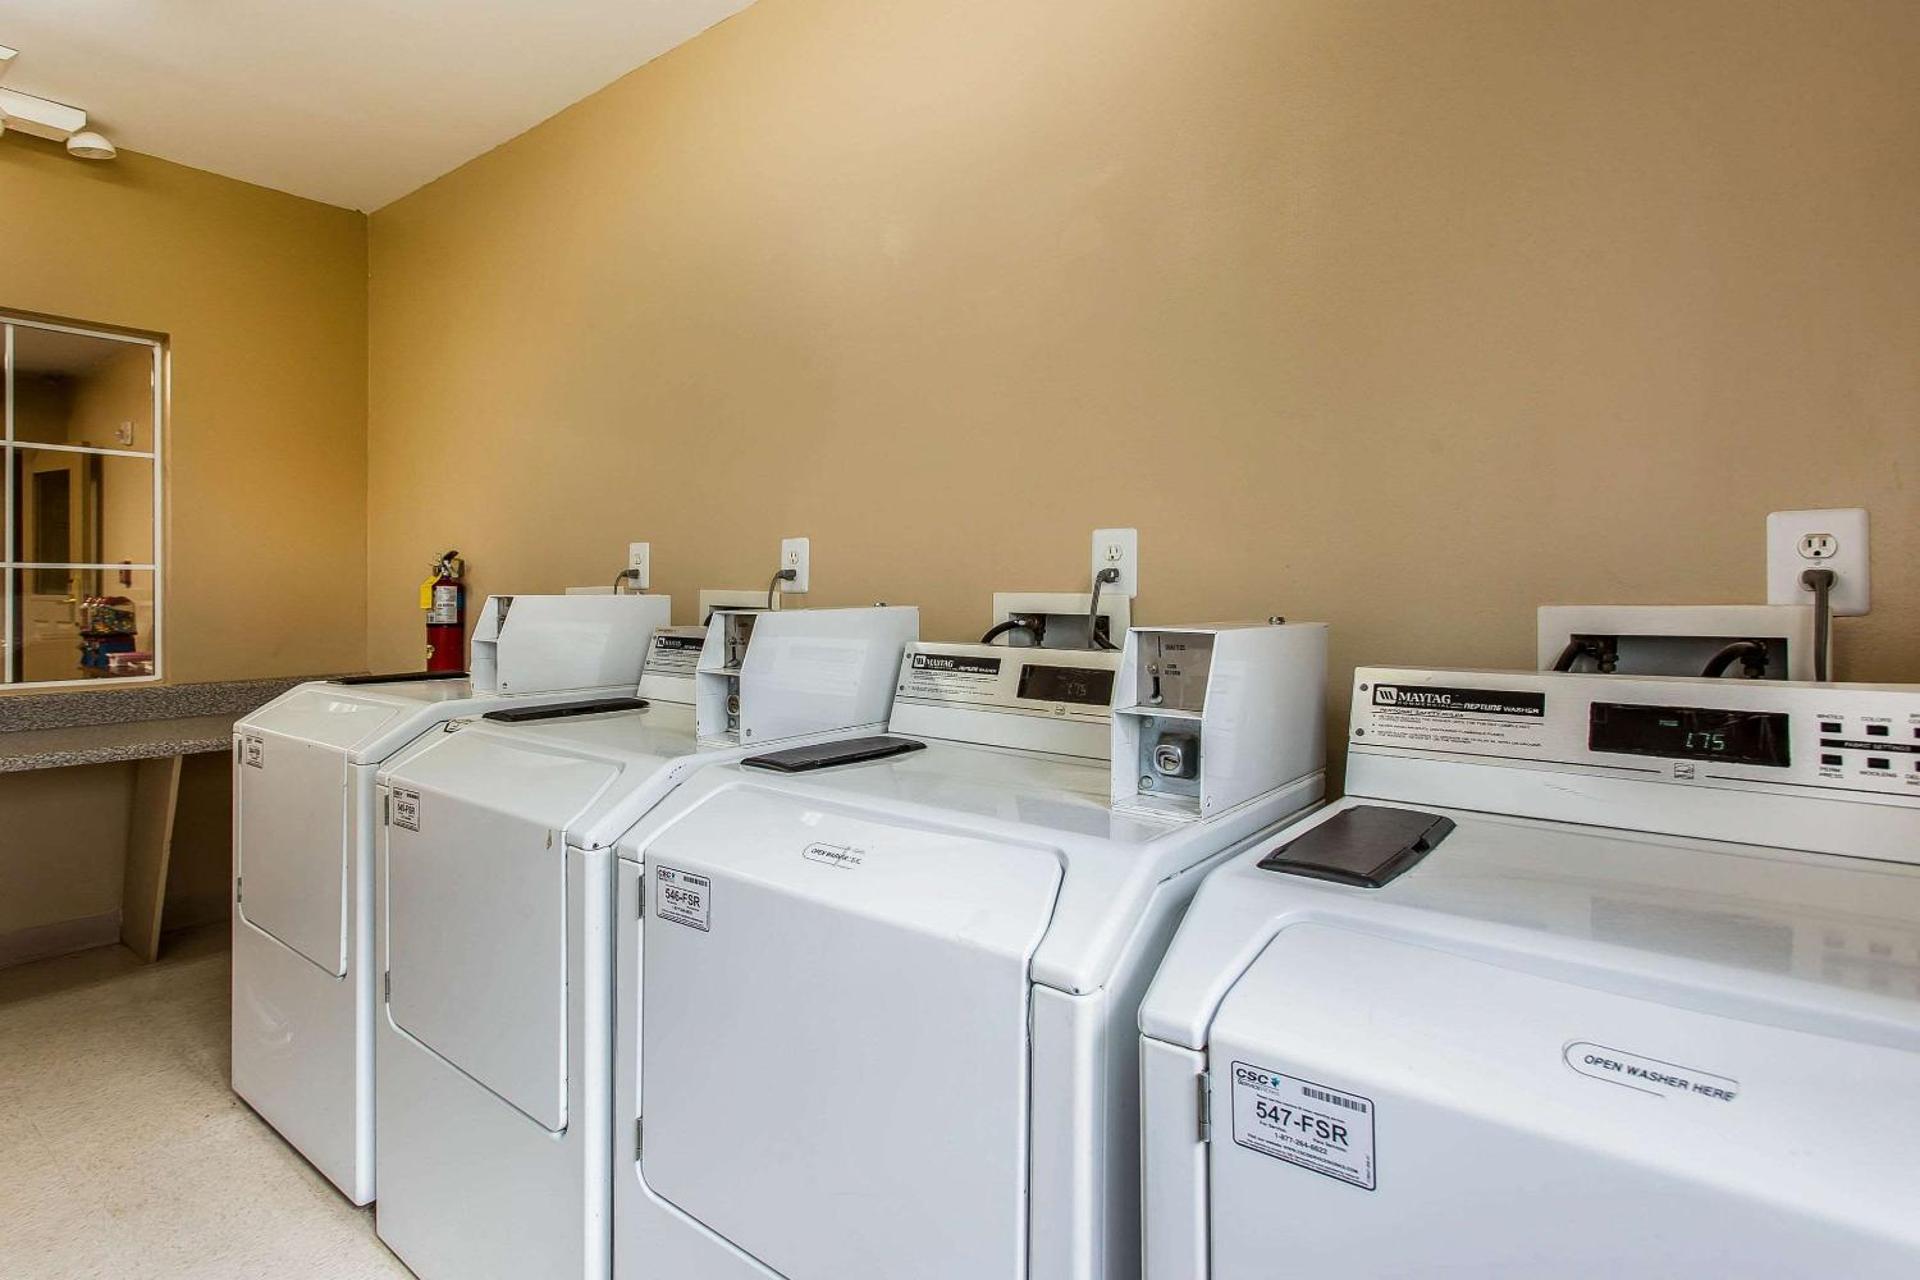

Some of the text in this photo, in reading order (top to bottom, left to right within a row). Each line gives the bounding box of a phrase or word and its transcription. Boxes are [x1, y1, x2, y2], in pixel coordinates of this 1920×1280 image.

[1398, 691, 1451, 704] MAYTAG
[1503, 705, 1540, 714] WASHER
[665, 888, 701, 908] 546-FSR
[1235, 1068, 1269, 1085] CSC
[1583, 1054, 1738, 1102] OPEN WASHER HERE
[1255, 1100, 1349, 1147] 547-FSR
